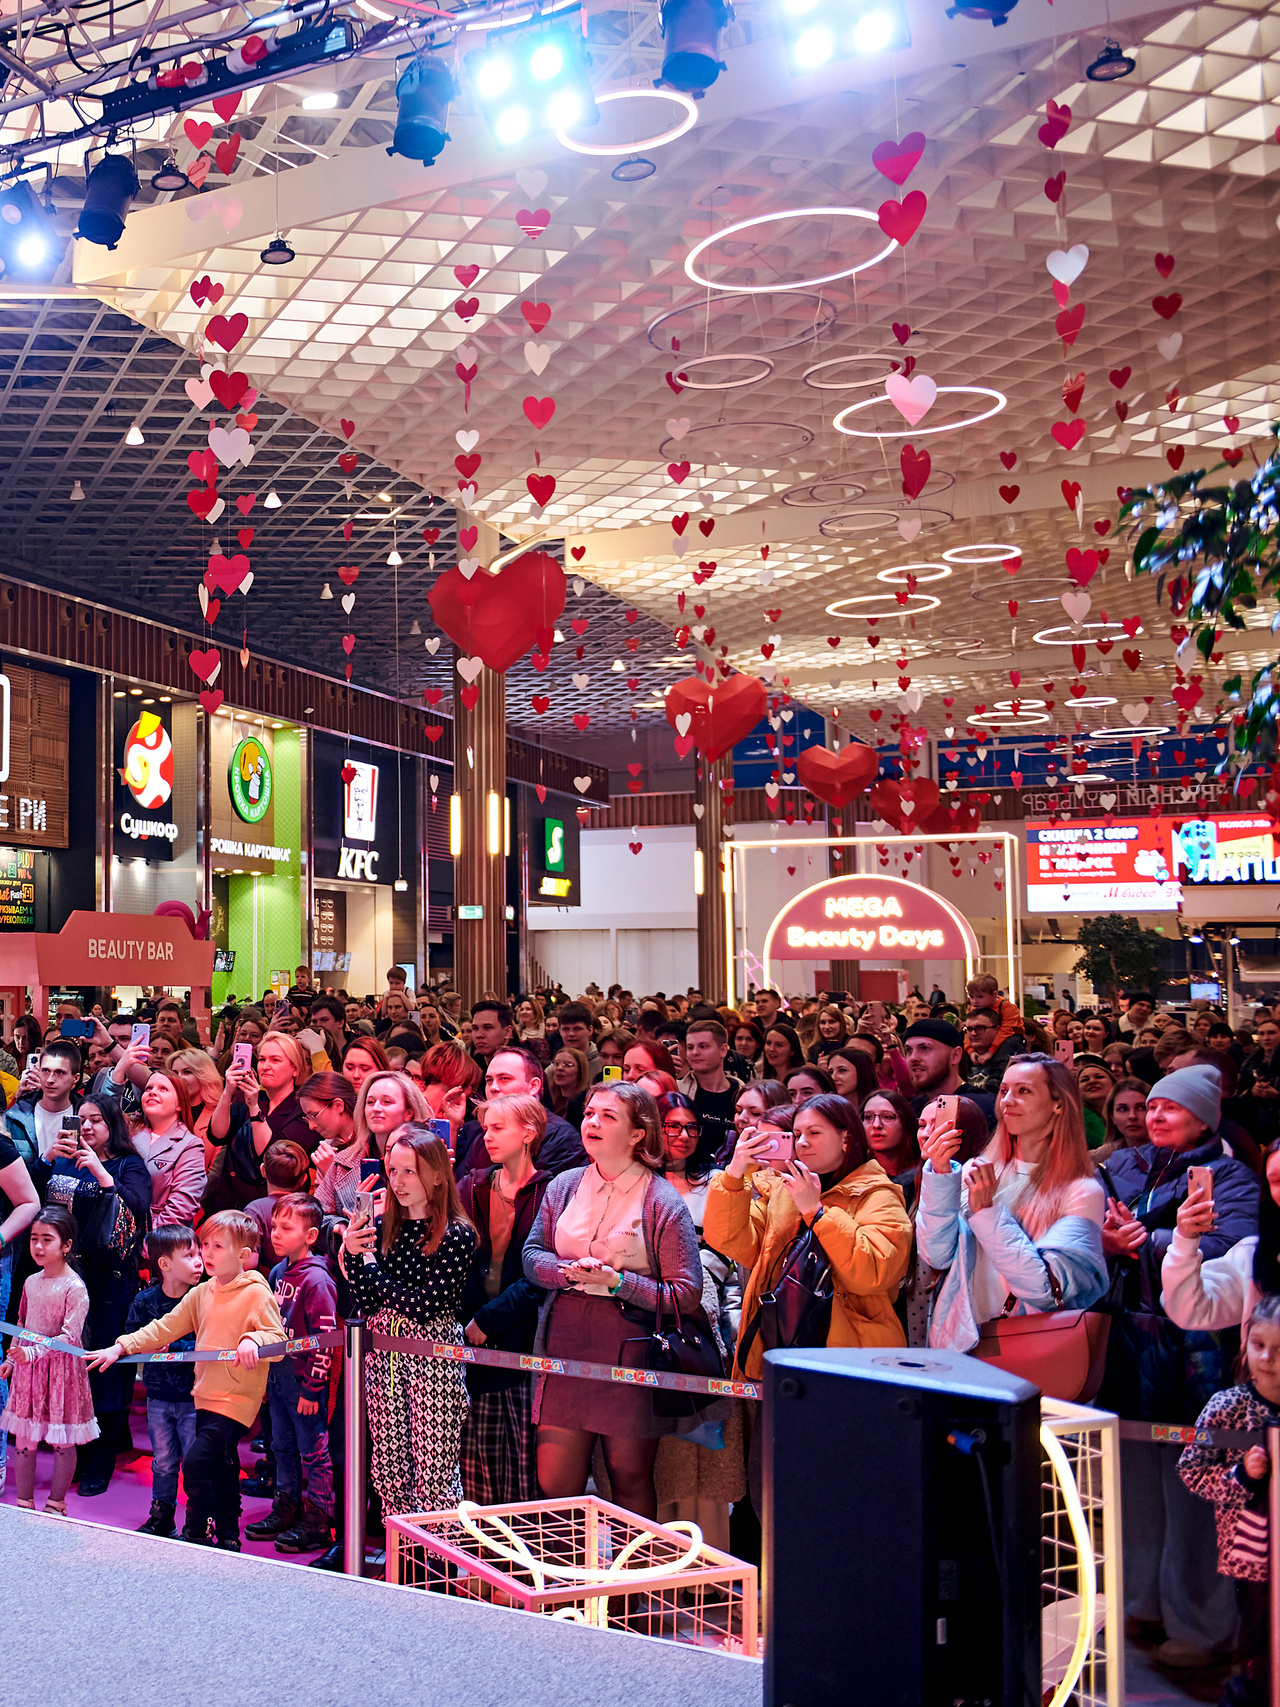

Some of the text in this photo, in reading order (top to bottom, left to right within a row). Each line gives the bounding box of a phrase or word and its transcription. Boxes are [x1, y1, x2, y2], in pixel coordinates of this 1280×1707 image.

[20, 798, 47, 832] РИ
[120, 812, 179, 842] Сушкоф
[337, 847, 379, 881] KFC
[825, 896, 902, 918] MEGA
[88, 938, 174, 960] BEAUTY BAR
[787, 925, 944, 950] Beauty Days
